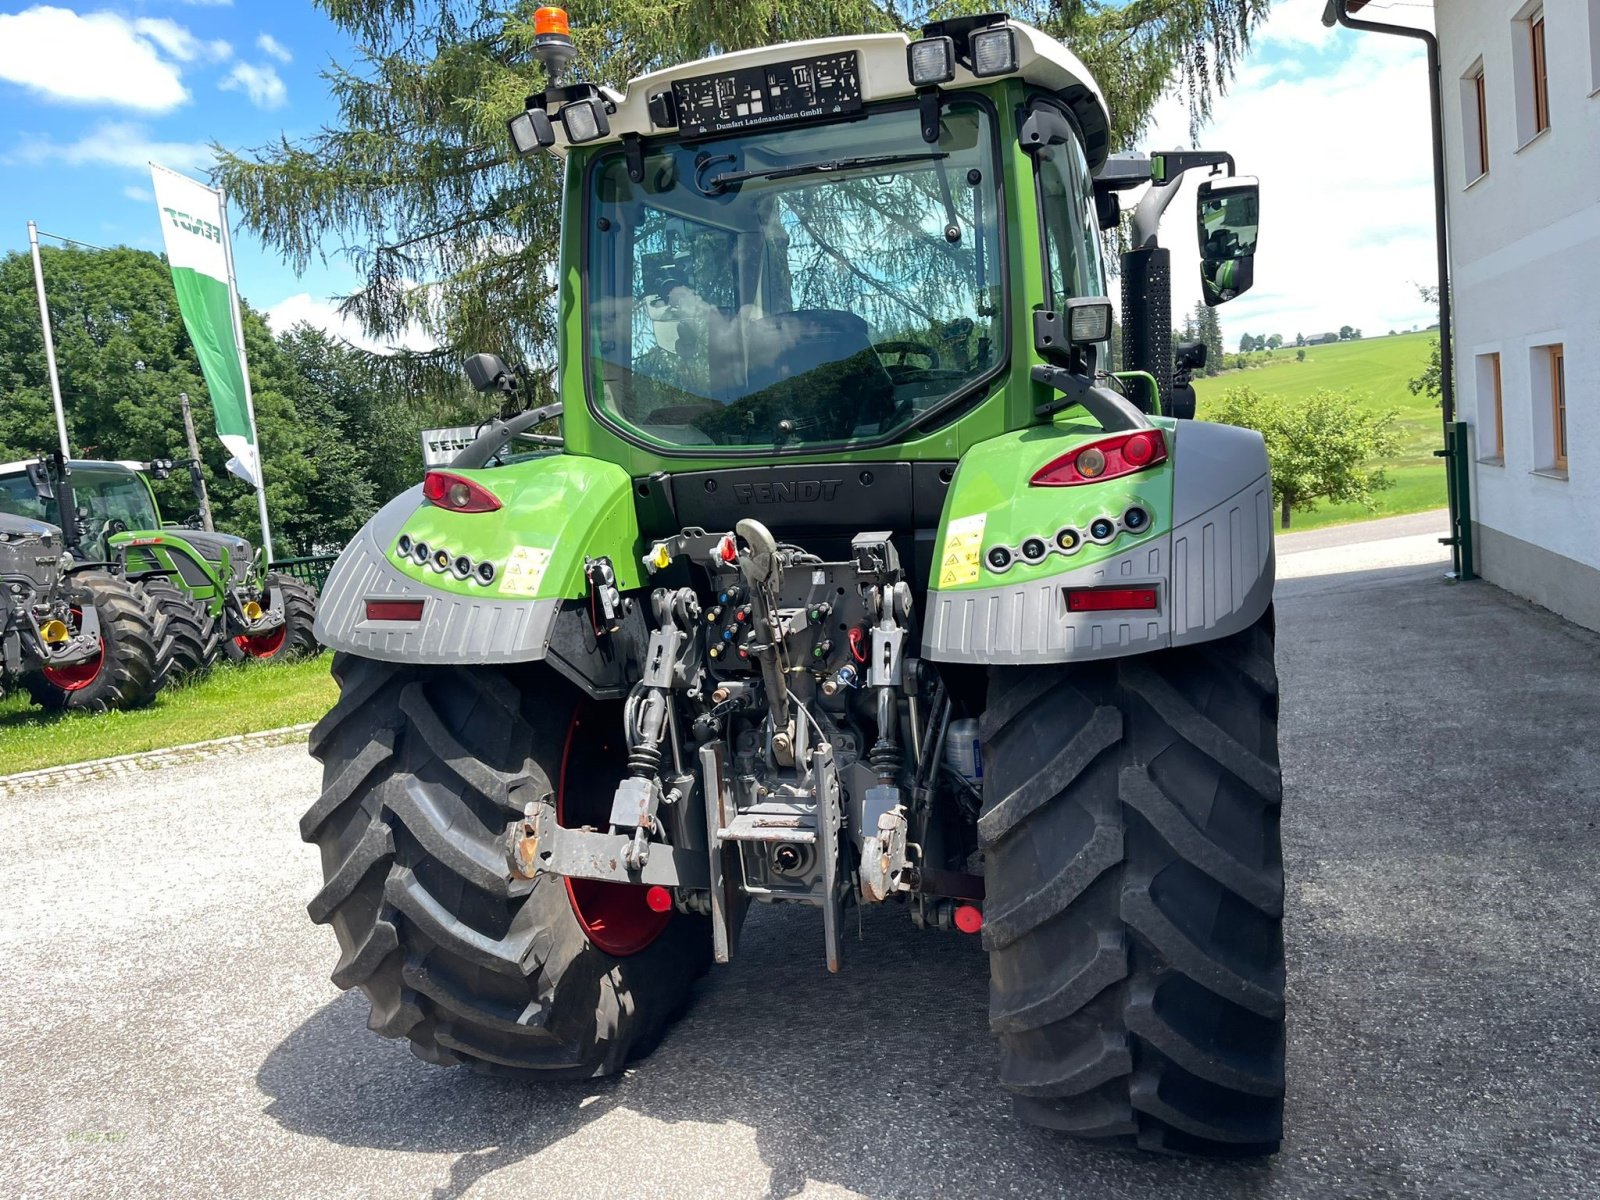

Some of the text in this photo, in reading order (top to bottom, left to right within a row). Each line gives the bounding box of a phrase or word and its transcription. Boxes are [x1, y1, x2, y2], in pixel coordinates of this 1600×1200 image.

[716, 108, 823, 130] Dumfart Landmaschinen GmbH
[733, 480, 843, 504] FENDT
